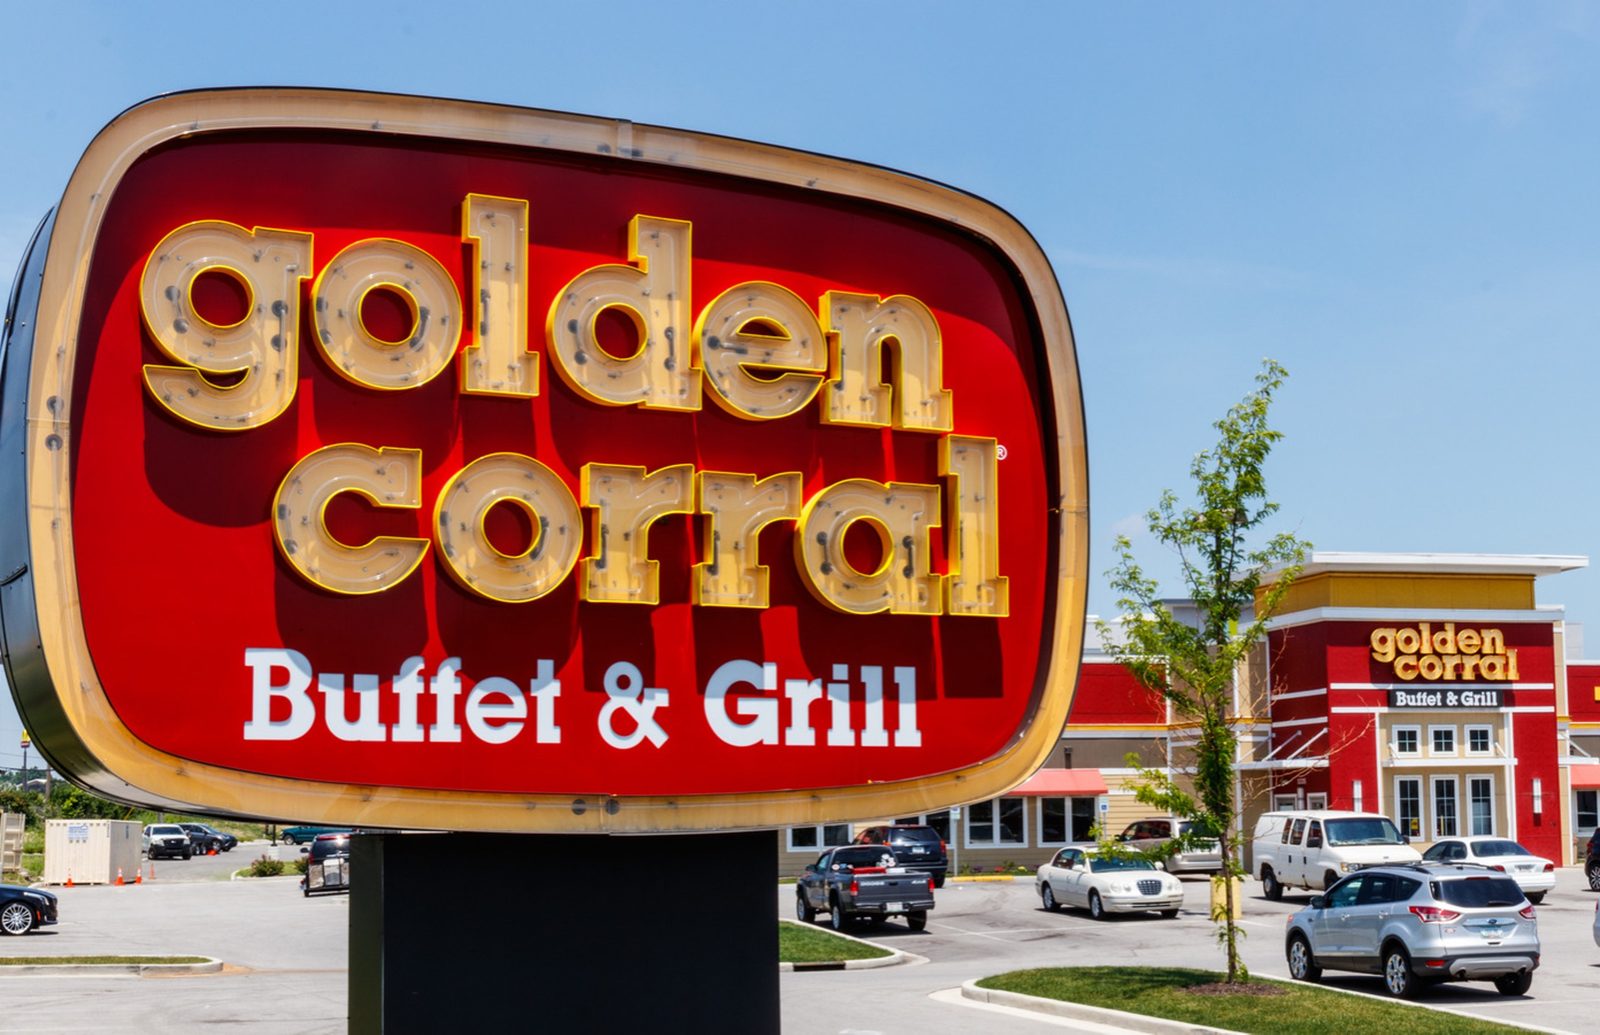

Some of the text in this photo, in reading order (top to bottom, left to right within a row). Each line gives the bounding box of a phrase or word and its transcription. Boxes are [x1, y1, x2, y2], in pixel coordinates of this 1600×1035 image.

[140, 193, 954, 431] golden
[272, 433, 1011, 618] corral
[1370, 622, 1506, 663] golden
[1393, 650, 1520, 680] corral
[243, 648, 923, 750] Buffet & Grill
[1396, 691, 1498, 706] Buffet & Grill
